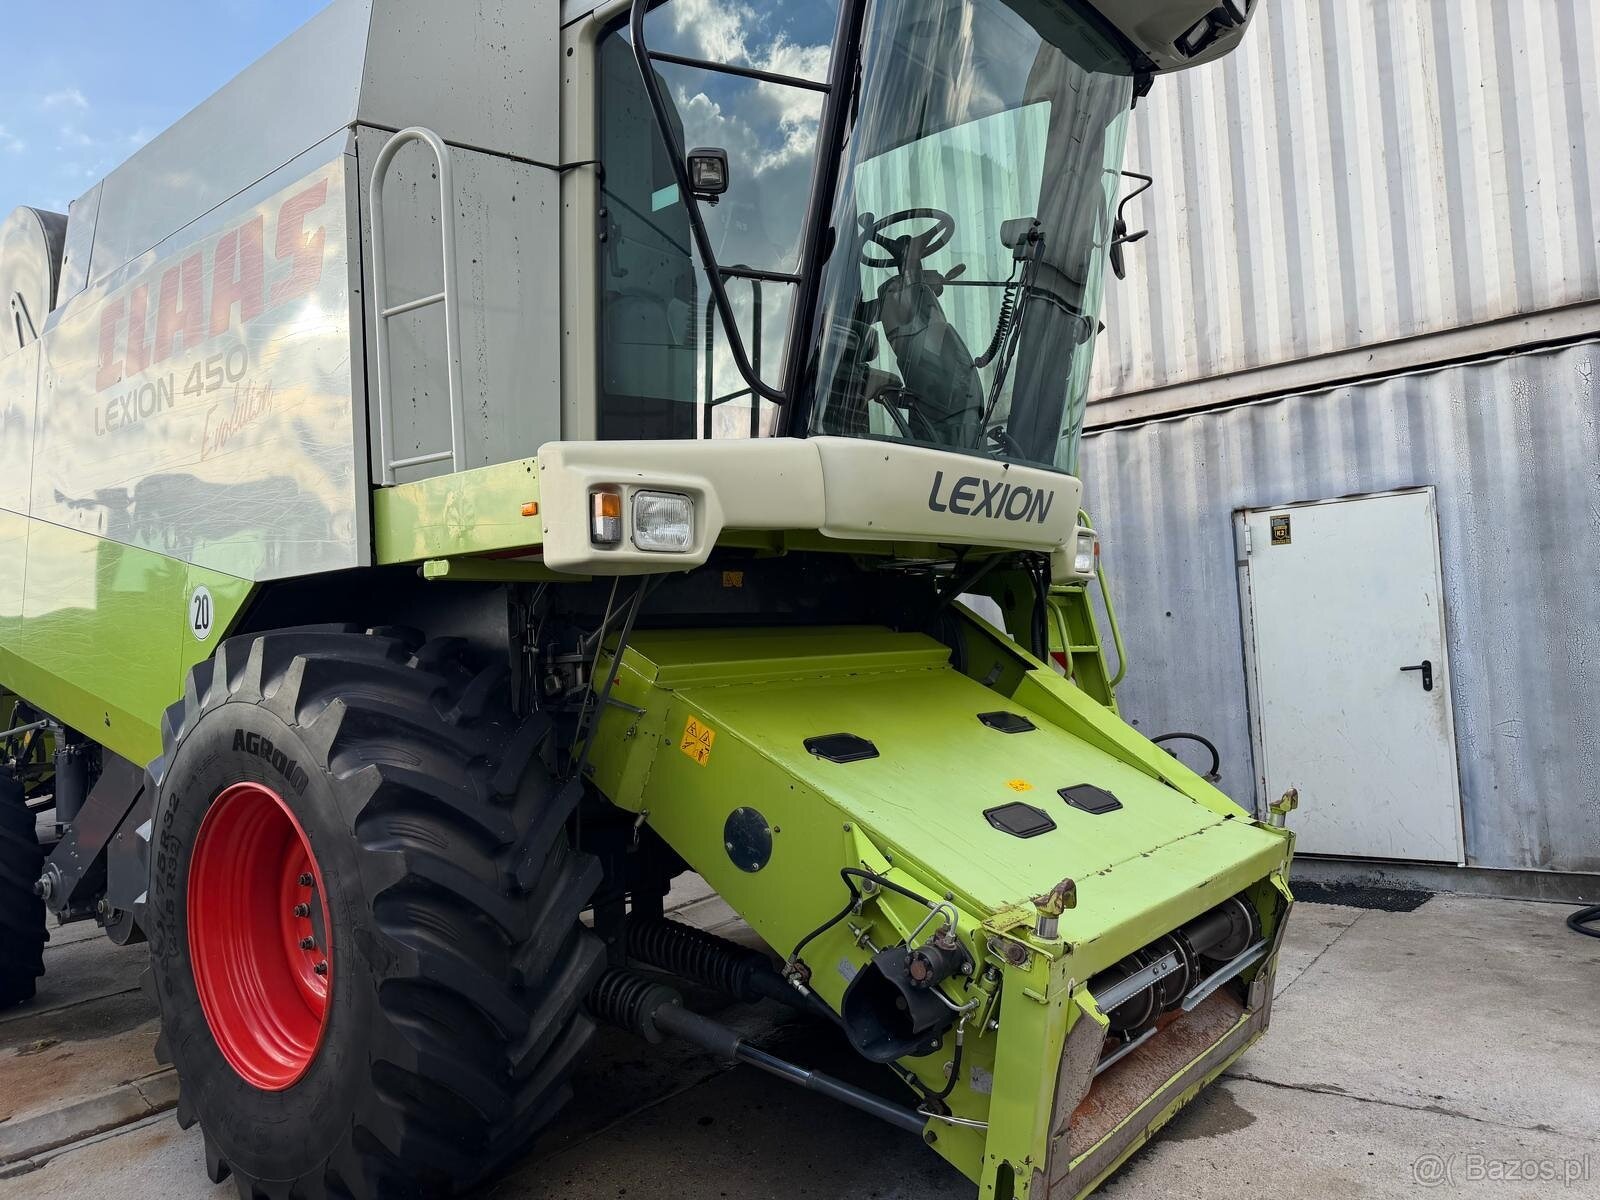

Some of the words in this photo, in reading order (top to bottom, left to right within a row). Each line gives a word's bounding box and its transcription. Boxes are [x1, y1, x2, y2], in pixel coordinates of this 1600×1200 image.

[95, 177, 328, 392] CLAAS
[94, 372, 174, 436] LEXION
[183, 343, 248, 397] 450
[928, 471, 1054, 524] LEXION
[194, 593, 209, 630] 20
